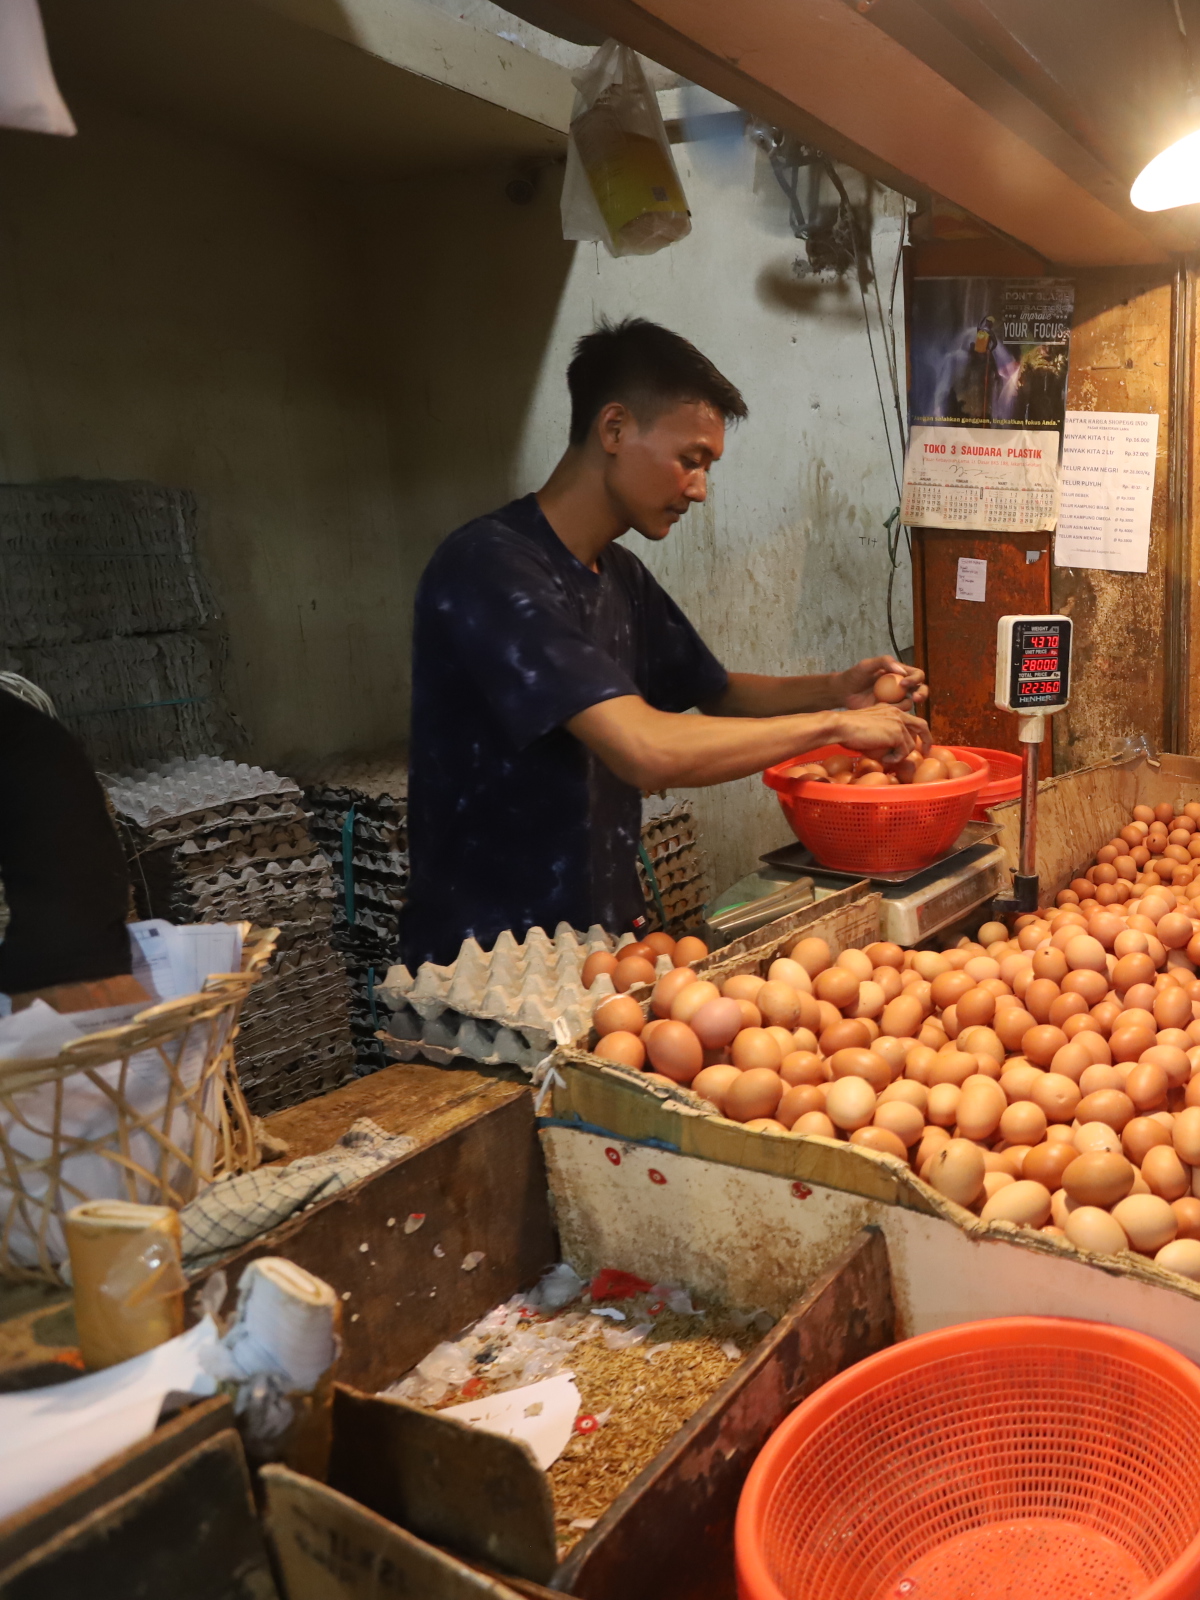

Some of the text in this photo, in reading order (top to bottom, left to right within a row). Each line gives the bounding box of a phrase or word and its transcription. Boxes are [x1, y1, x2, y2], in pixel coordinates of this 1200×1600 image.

[1020, 312, 1052, 321] improve
[1004, 322, 1028, 337] YOUR
[924, 444, 1042, 459] TOKO 3 SAUDARA PLASTIK
[1022, 659, 1058, 671] 28000
[1022, 681, 1060, 694] 122360
